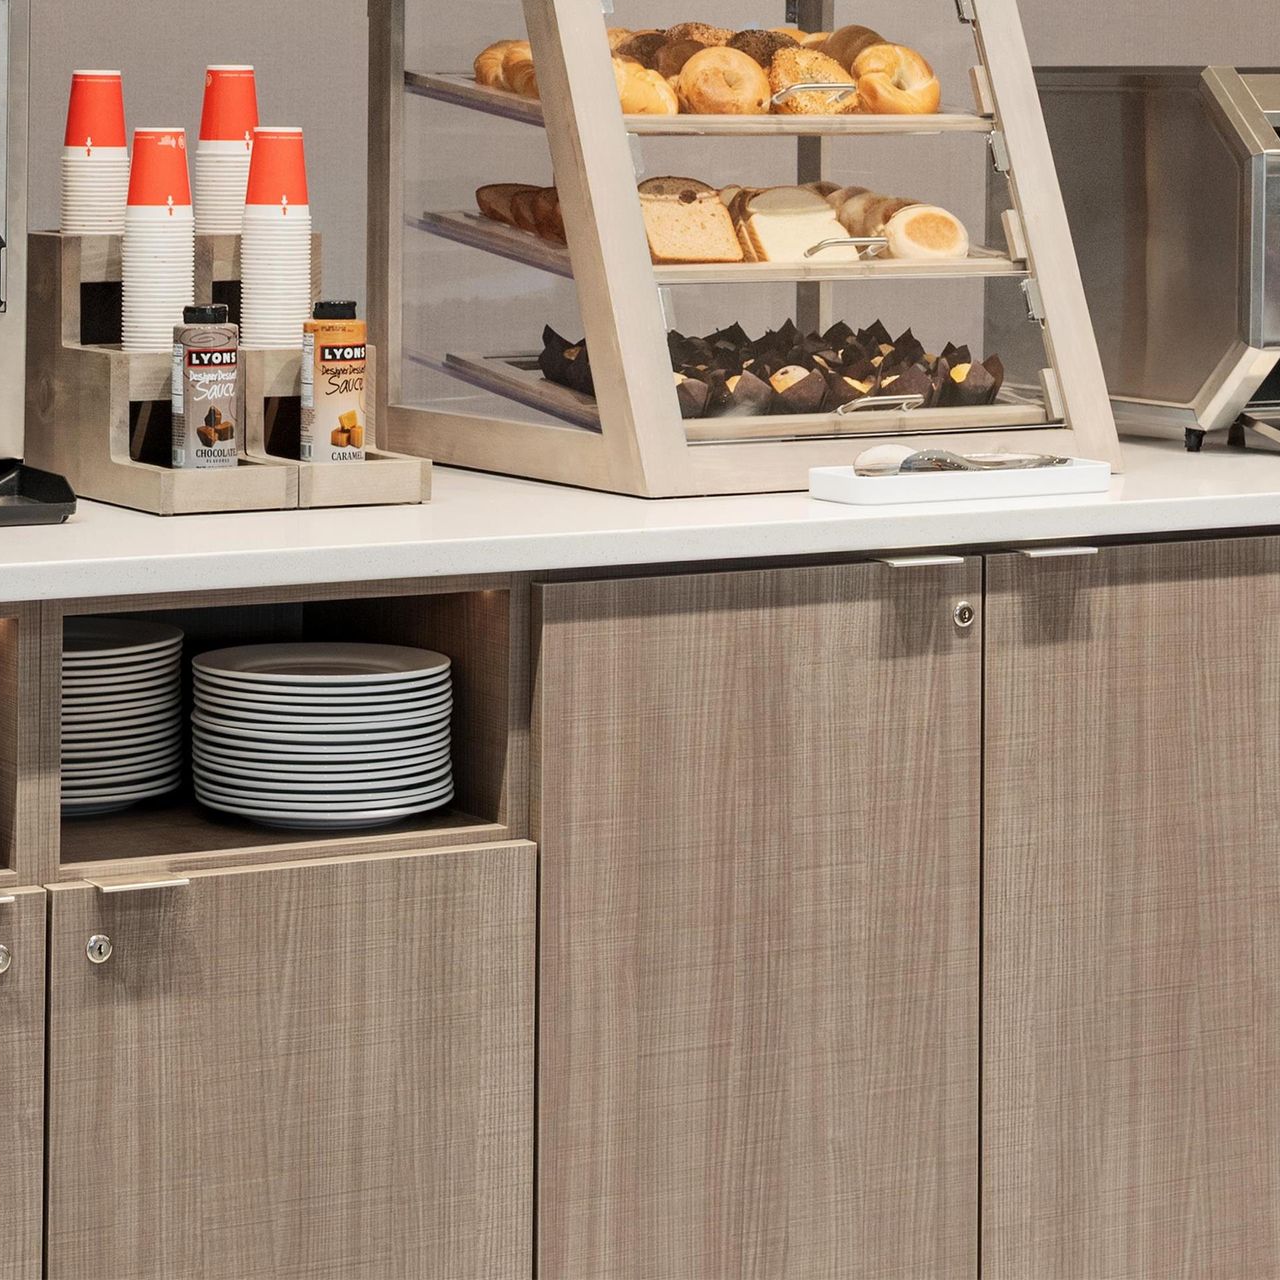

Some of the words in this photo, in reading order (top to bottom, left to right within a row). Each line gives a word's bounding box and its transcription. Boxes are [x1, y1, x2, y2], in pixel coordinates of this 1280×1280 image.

[191, 352, 236, 364] LYONS
[324, 347, 365, 359] LYONS
[193, 381, 235, 401] Sauce
[325, 375, 364, 395] Sauce
[195, 448, 237, 458] CHOCOLATE
[331, 451, 364, 461] CARAMEL
